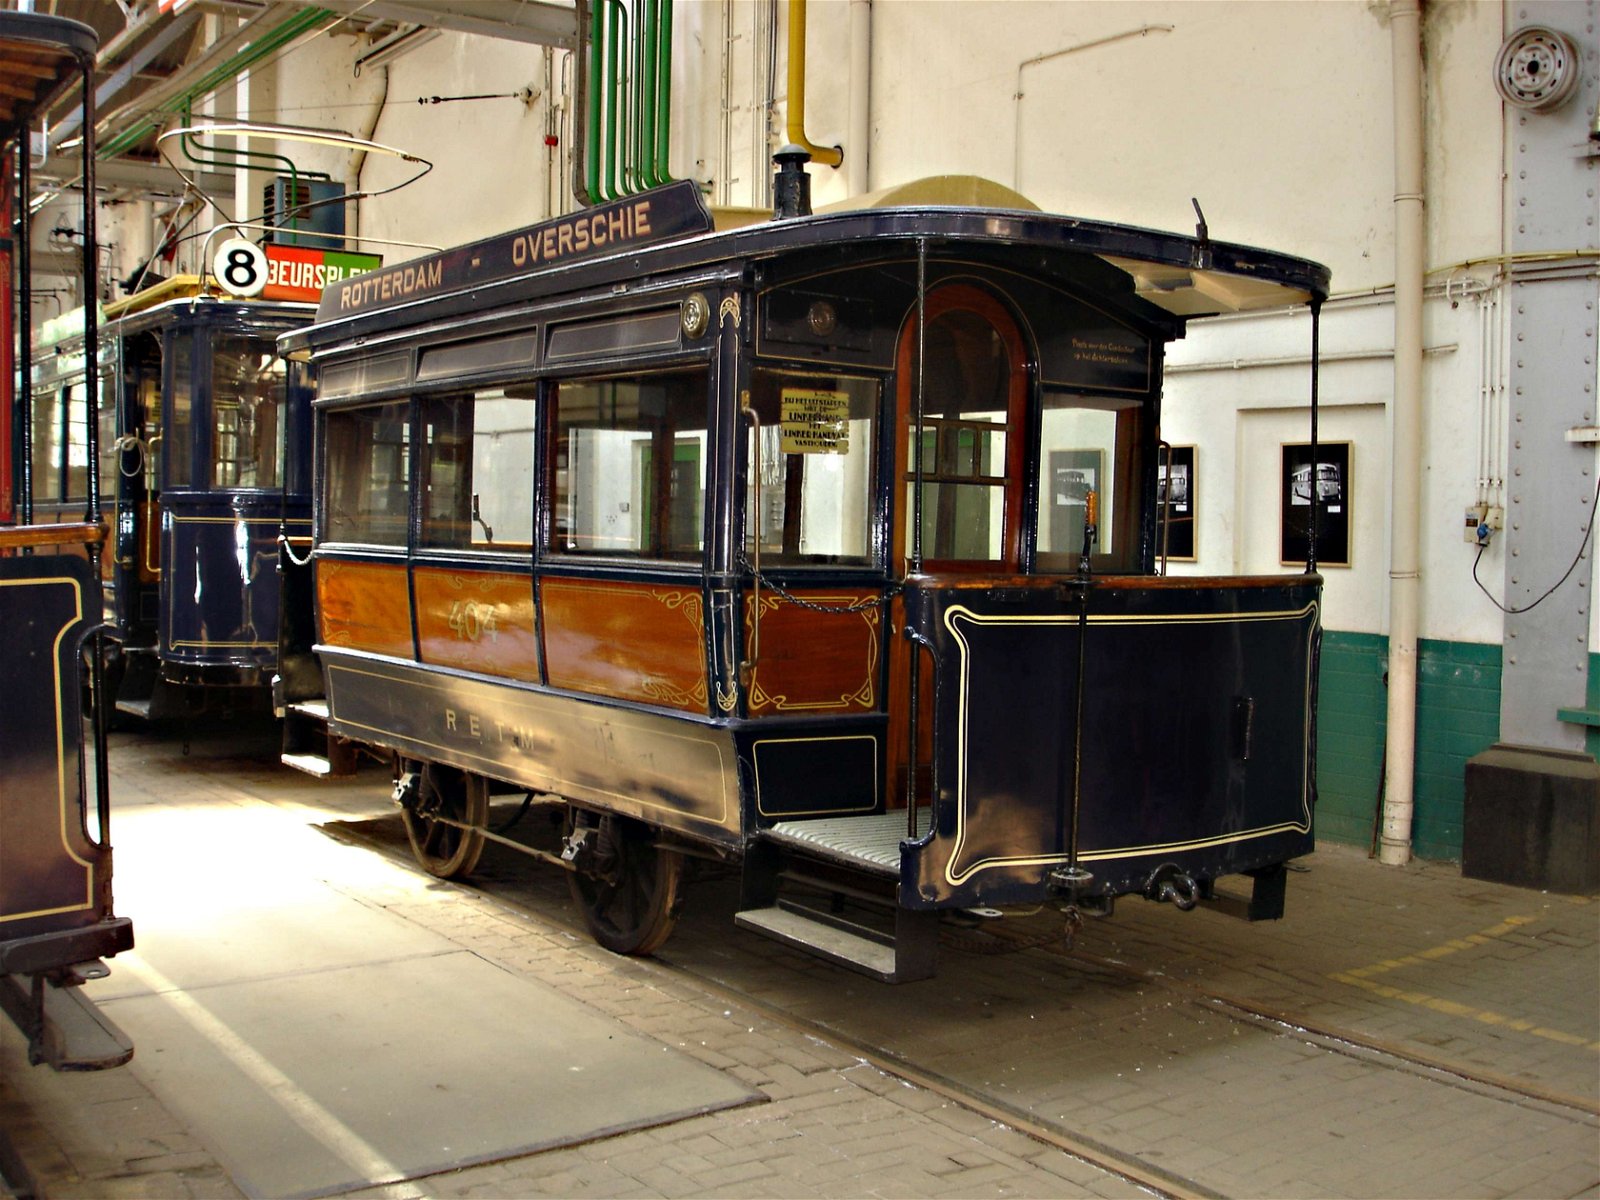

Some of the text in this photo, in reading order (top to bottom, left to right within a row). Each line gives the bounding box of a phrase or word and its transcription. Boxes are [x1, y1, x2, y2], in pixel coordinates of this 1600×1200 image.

[225, 248, 257, 287] 8
[267, 259, 372, 289] BEURSPL
[341, 259, 442, 310] ROTTERDAM
[512, 200, 651, 268] OVERSCHIE
[449, 600, 499, 644] 404
